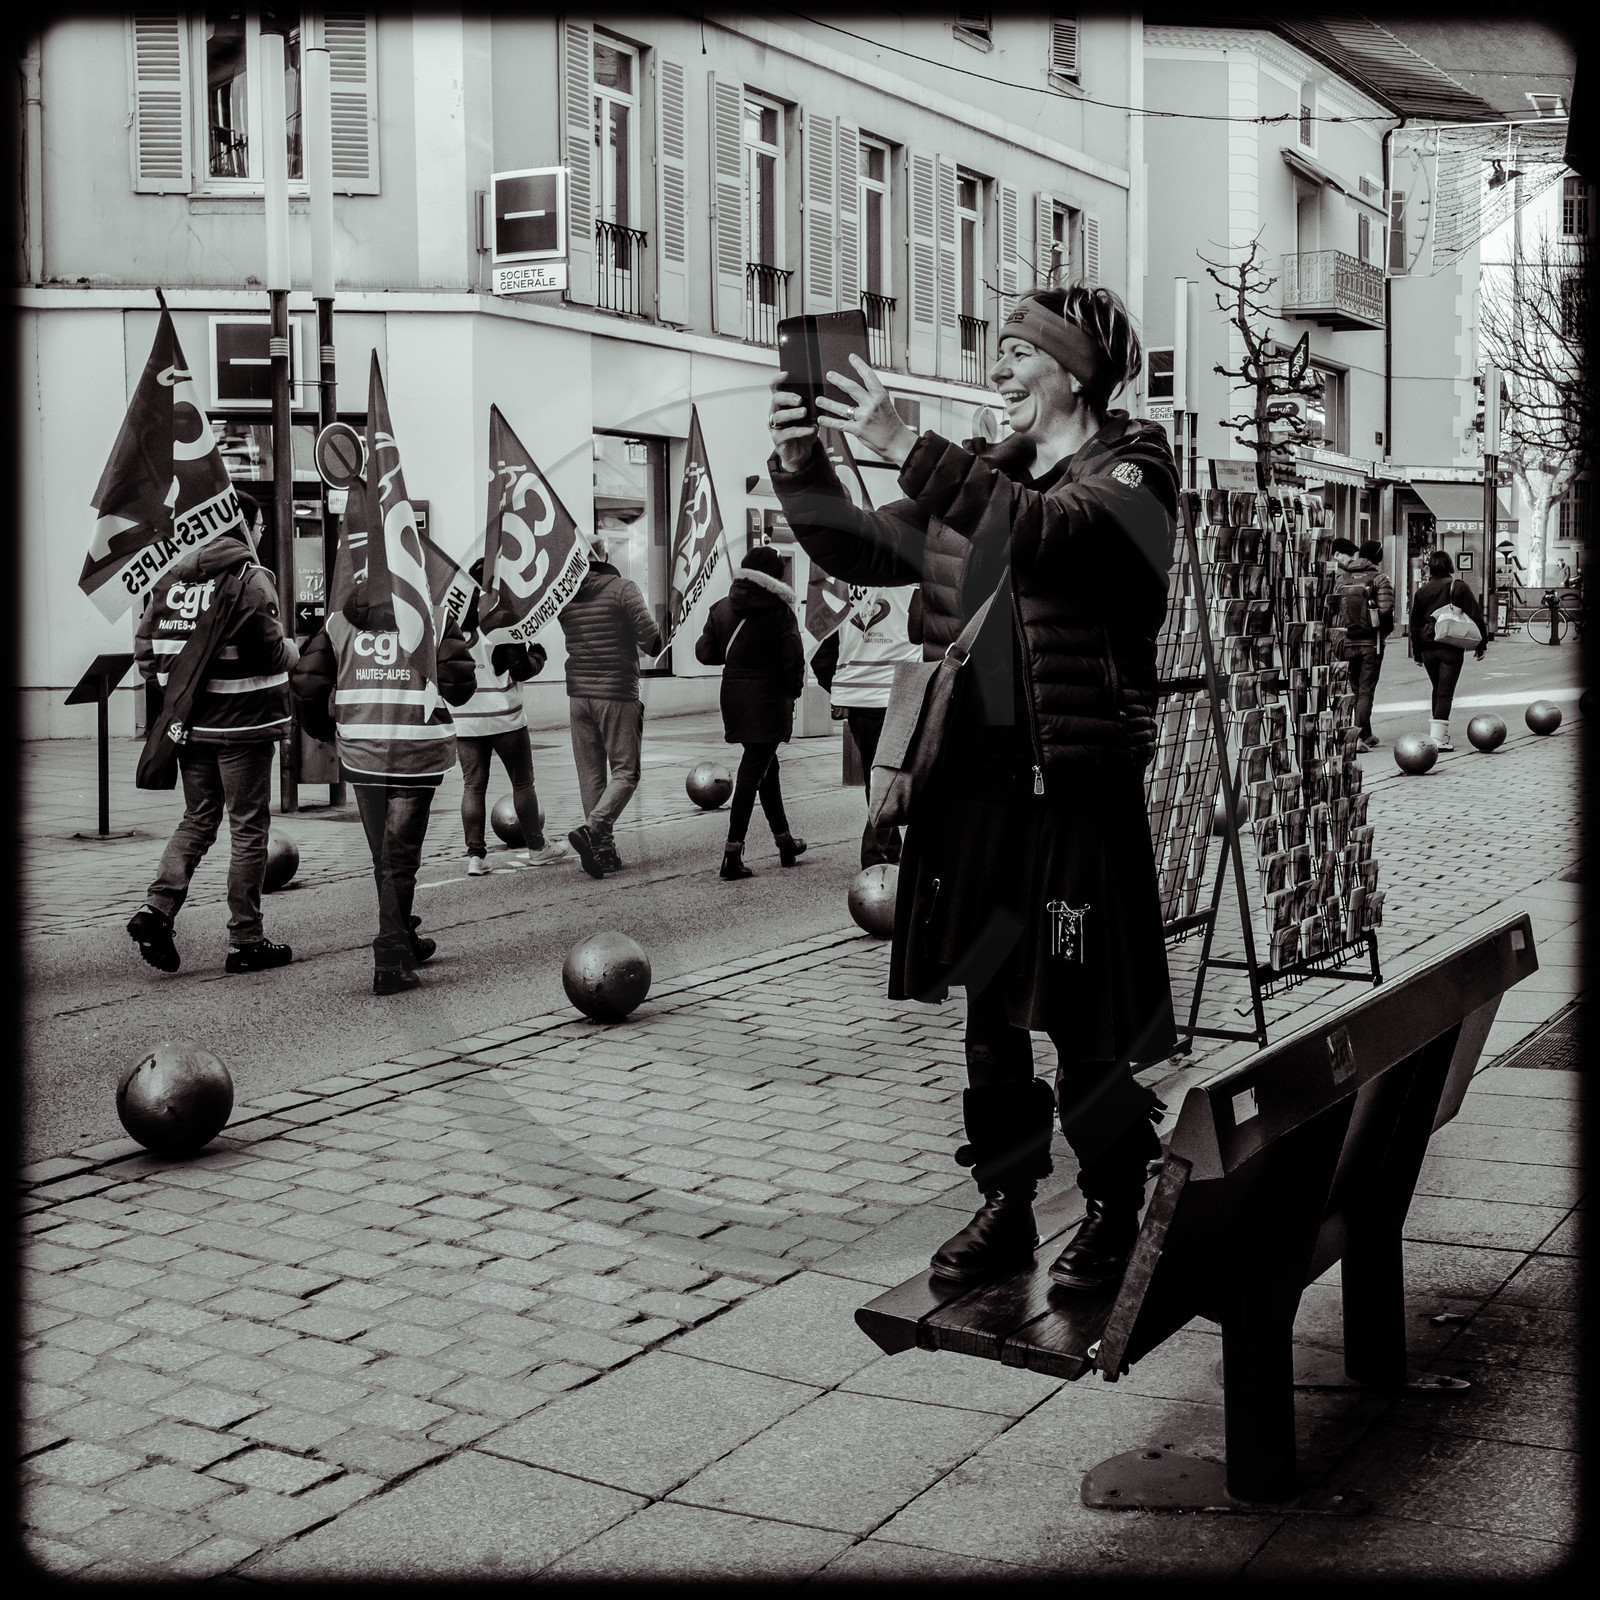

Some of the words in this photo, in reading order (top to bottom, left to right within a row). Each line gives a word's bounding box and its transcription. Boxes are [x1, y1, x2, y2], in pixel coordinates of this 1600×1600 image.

[500, 268, 545, 281] SOCIETE
[500, 277, 556, 291] GENERALE
[1149, 406, 1173, 414] SOCIE
[1446, 521, 1509, 531] PRESE
[304, 575, 324, 592] 7j/
[165, 579, 217, 619] cgt
[299, 591, 325, 602] 6h-2
[353, 632, 399, 666] cg
[355, 669, 411, 681] HAUTES-ALPES
